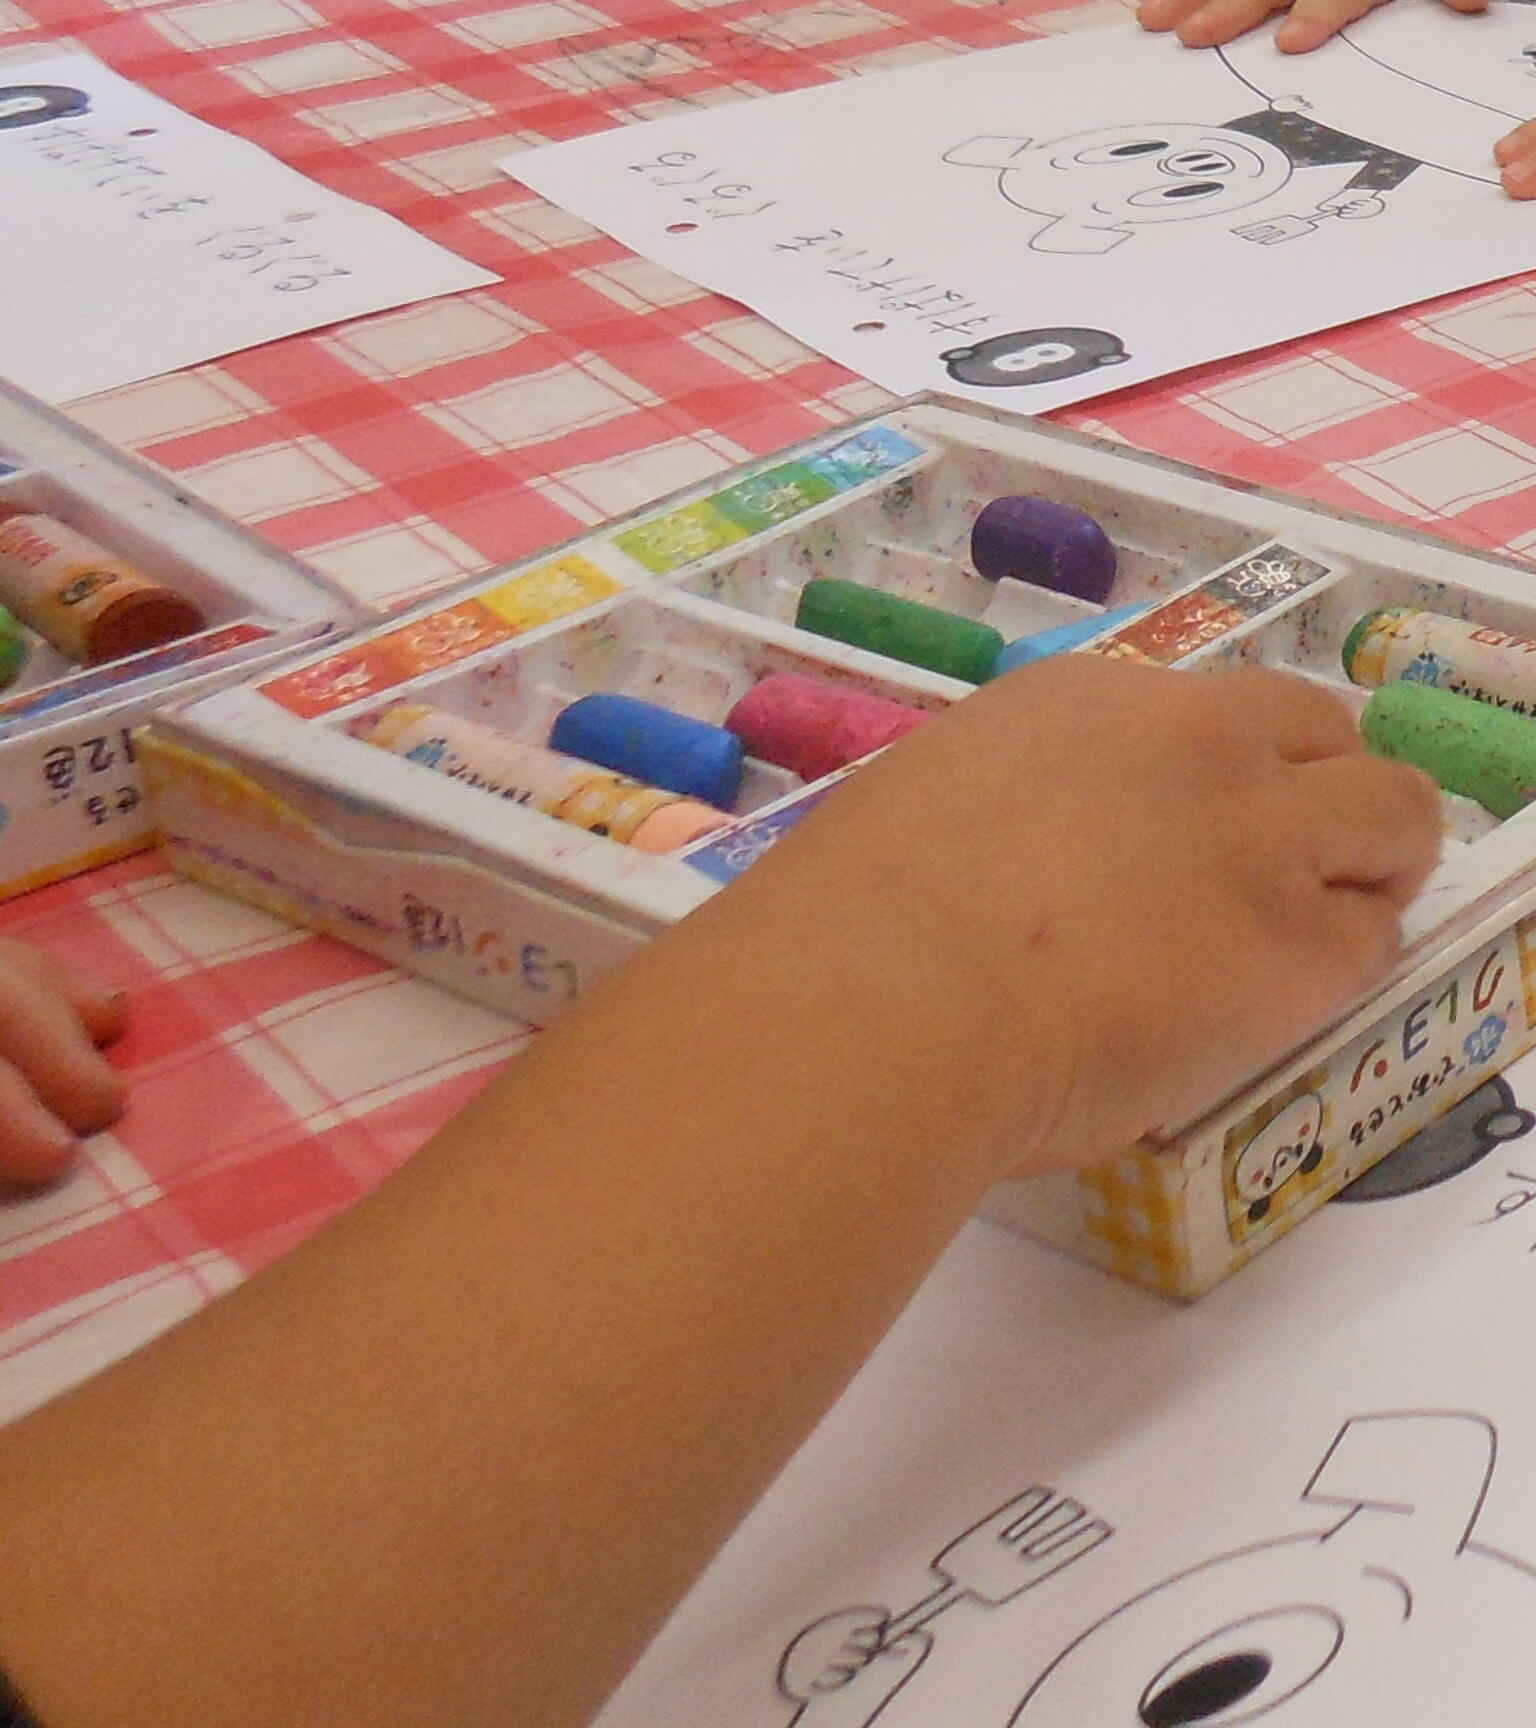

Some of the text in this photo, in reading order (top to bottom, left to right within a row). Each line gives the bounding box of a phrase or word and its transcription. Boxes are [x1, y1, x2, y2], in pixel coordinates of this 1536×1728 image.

[628, 151, 776, 219] ぐるぐる
[1350, 950, 1505, 1094] クレヨン
